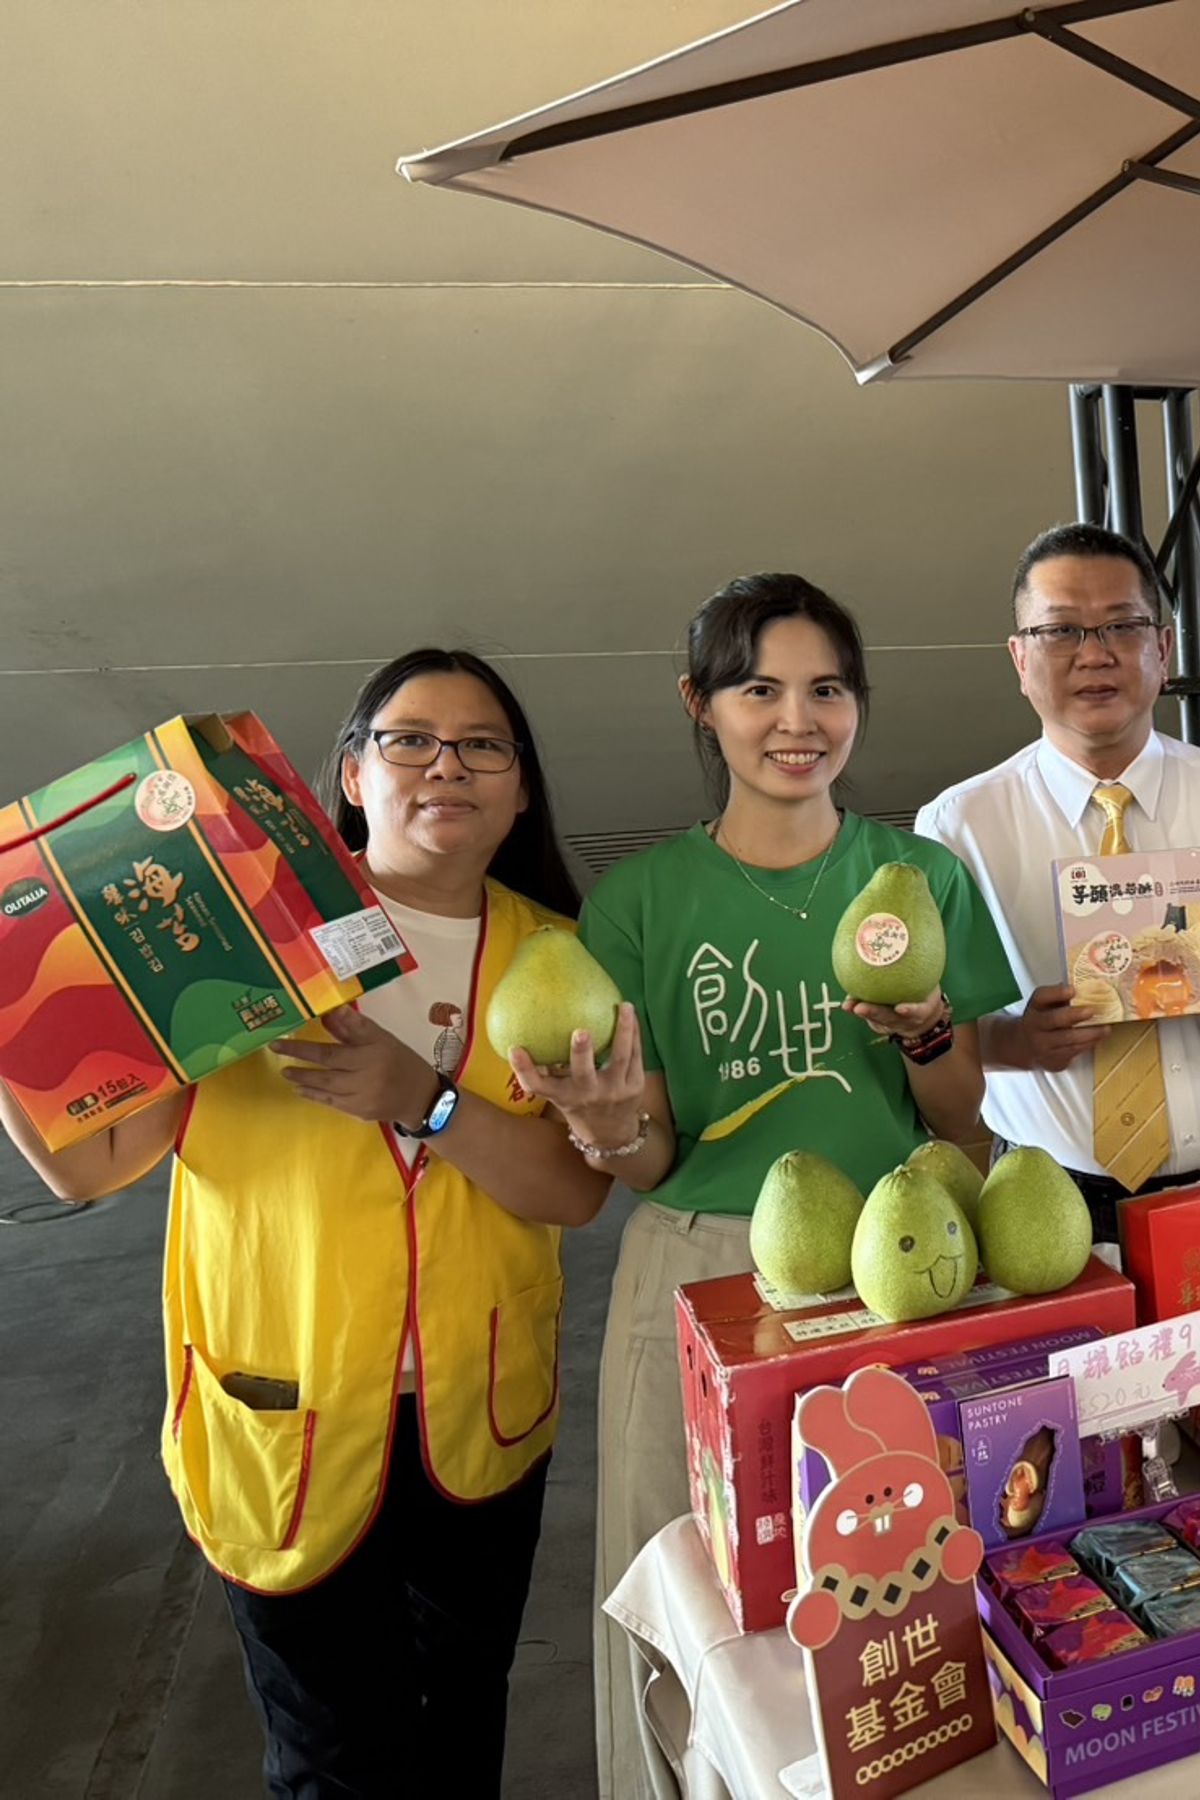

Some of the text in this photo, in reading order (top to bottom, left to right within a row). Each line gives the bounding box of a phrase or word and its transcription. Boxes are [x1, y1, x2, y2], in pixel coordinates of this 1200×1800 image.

[686, 938, 852, 1093] 創世
[967, 1396, 1023, 1419] SUNTONE
[968, 1413, 1010, 1432] PASTRY
[857, 1612, 942, 1689] 創世
[844, 1658, 967, 1754] 基金會
[1064, 1724, 1137, 1766] MOON
